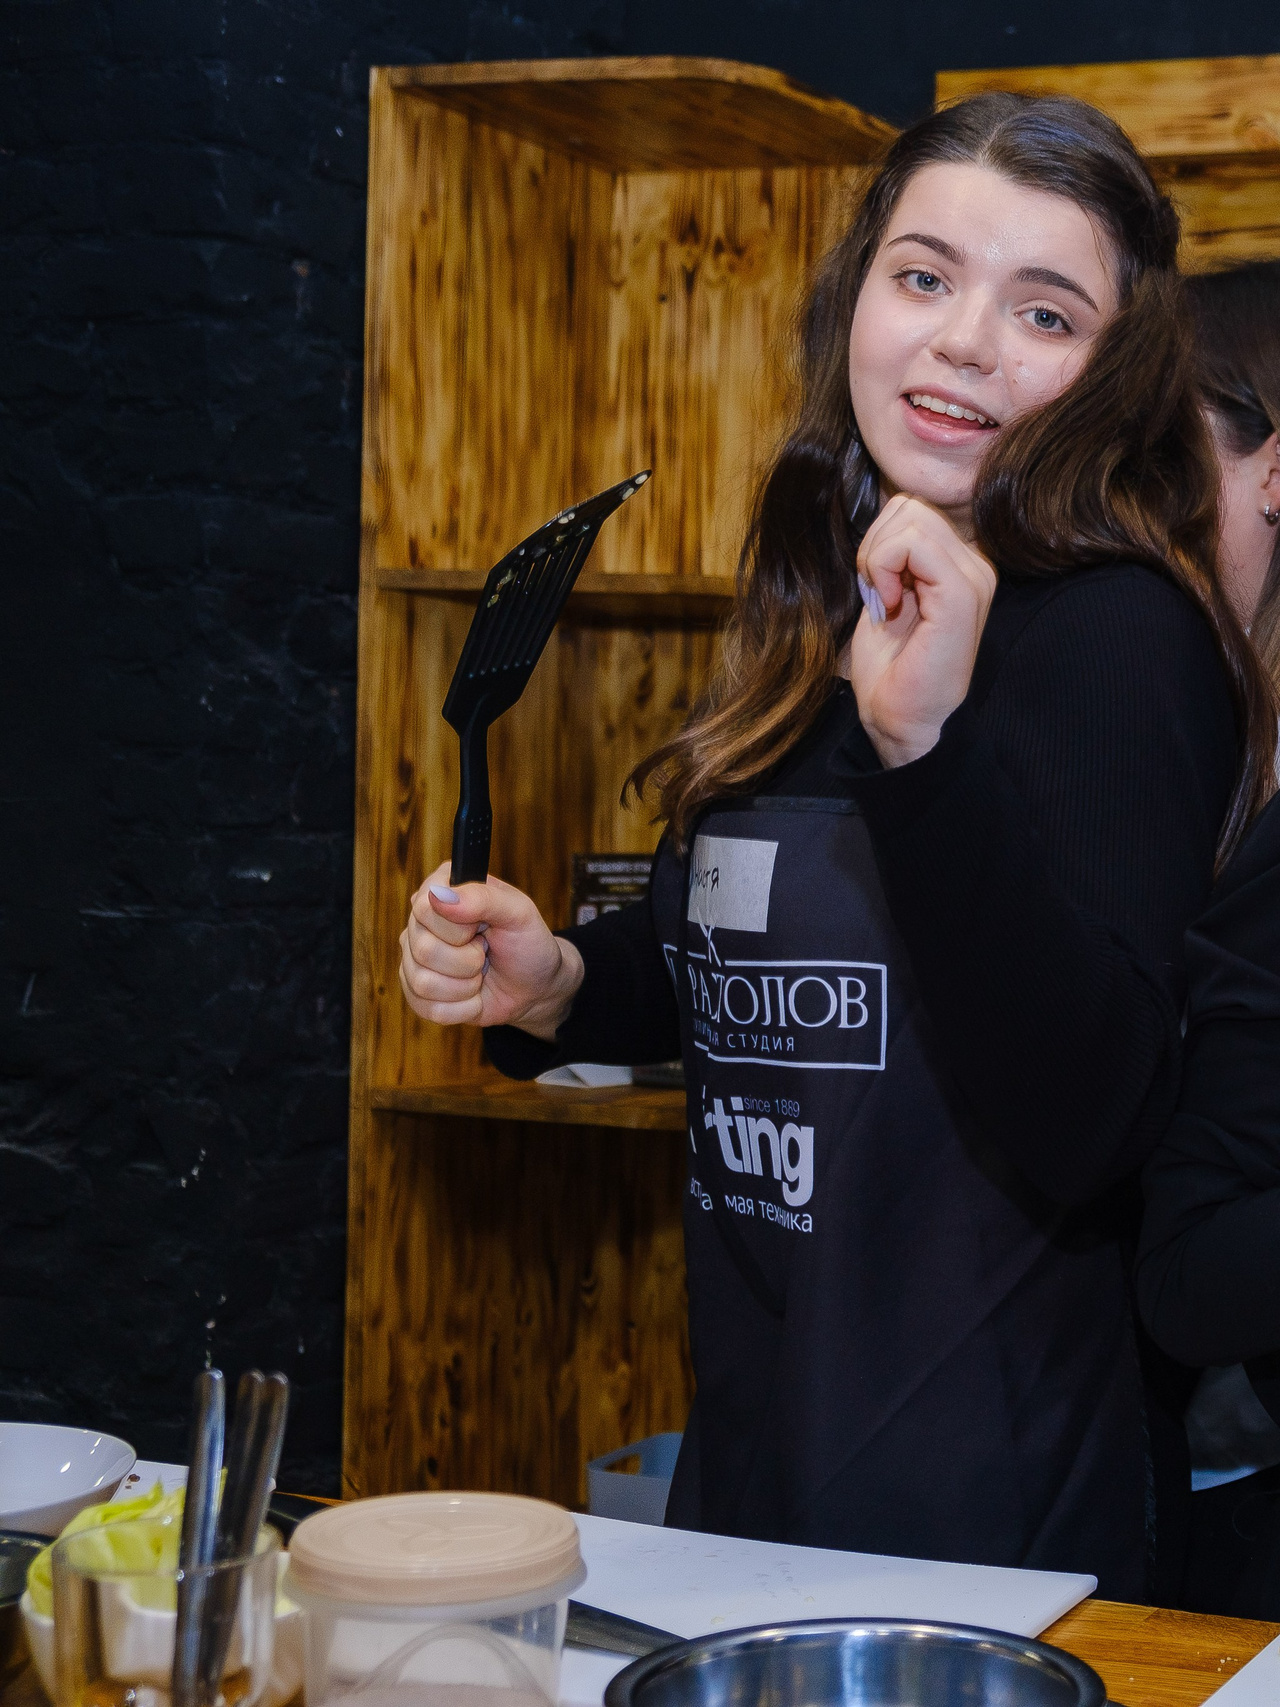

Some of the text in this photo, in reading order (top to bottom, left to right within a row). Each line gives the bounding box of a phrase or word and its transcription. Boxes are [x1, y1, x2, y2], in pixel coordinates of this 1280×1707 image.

[711, 971, 869, 1029] ТОЛОВ
[727, 1033, 795, 1053] СТУДИЯ
[743, 1097, 800, 1118] since 1889
[704, 1096, 815, 1207] ting
[758, 1200, 813, 1233] техника
